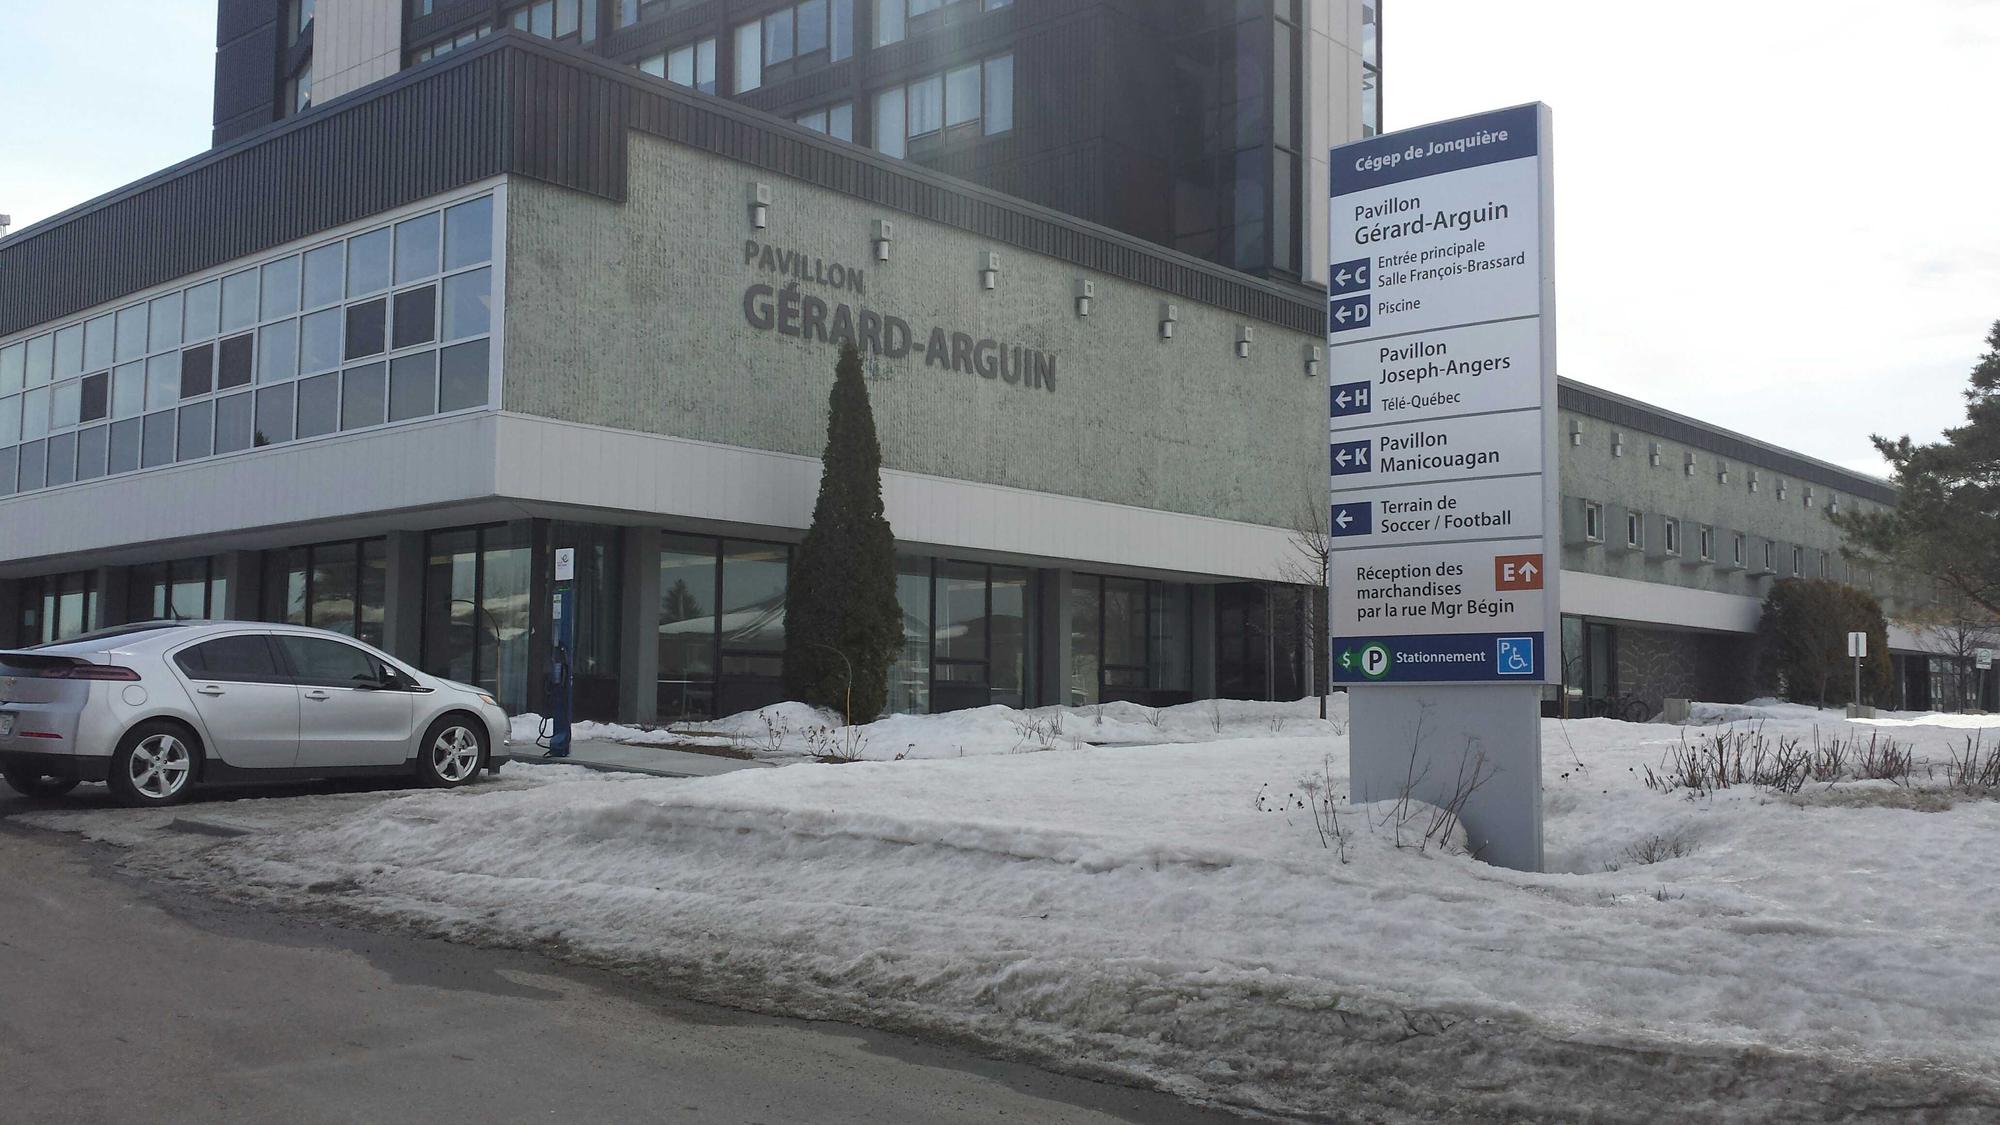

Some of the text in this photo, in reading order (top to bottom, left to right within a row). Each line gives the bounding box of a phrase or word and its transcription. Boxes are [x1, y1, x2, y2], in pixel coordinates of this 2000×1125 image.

[1356, 130, 1508, 171] Cégep de Jonquière
[1355, 197, 1420, 221] Pavillon
[1355, 202, 1508, 244] Gérard-Arguin
[1378, 239, 1485, 268] Entrée principale
[745, 240, 864, 294] PAVILLON
[1355, 266, 1366, 283] C
[1378, 252, 1525, 287] Salle François-Brassard
[1355, 304, 1367, 320] D
[1379, 299, 1420, 315] Piscine
[744, 281, 1056, 392] GÉRARD-ARGUIN
[1380, 342, 1446, 363] Pavillon
[1380, 357, 1510, 384] Joseph-Angers
[1355, 389, 1367, 406] H
[1382, 392, 1460, 411] Télé-Québec
[1380, 432, 1447, 451] Pavillon
[1355, 448, 1367, 465] K
[1380, 451, 1499, 473] Manicouagan
[1381, 496, 1456, 514] Terrain de
[1381, 510, 1511, 533] Soccer / Football
[1357, 562, 1463, 582] Réception des
[1503, 564, 1514, 582] E
[1357, 582, 1461, 600] marchandises
[1357, 599, 1514, 621] par la rue Mgr Bégin
[1396, 652, 1486, 663] Stationnement
[1502, 643, 1510, 653] P
[1369, 651, 1382, 670] P
